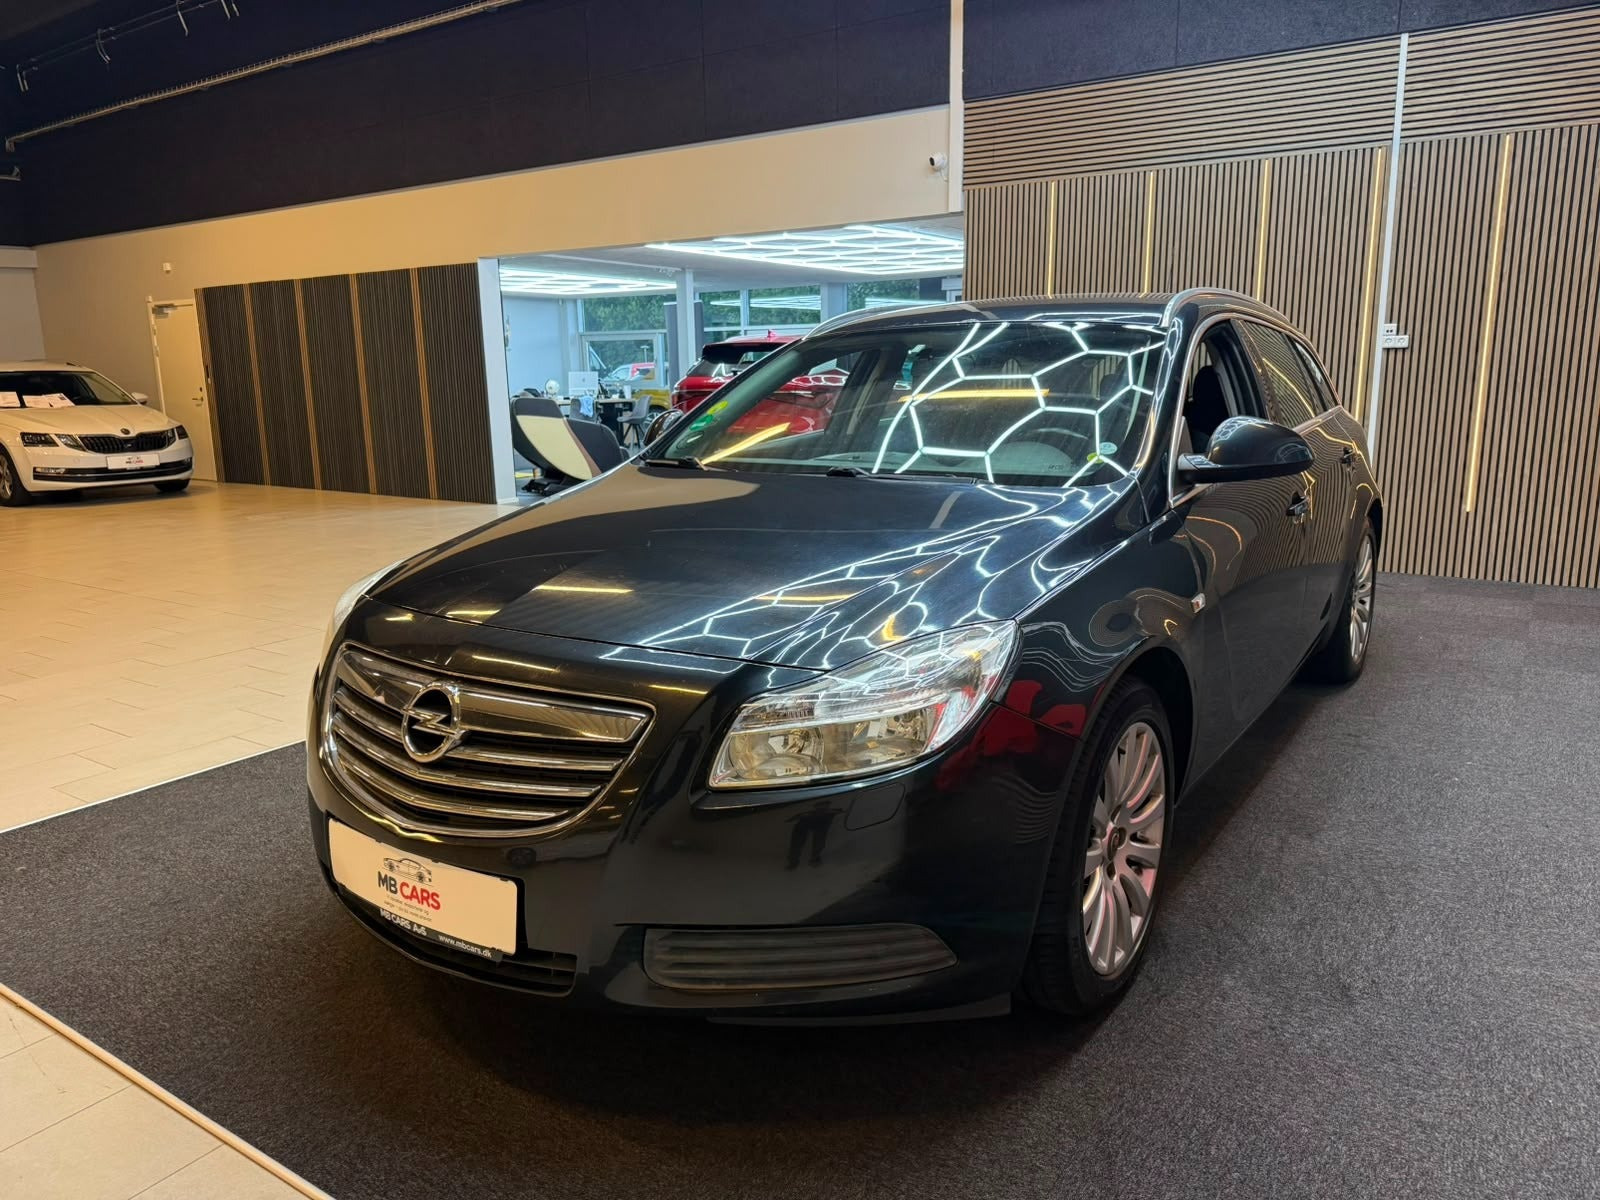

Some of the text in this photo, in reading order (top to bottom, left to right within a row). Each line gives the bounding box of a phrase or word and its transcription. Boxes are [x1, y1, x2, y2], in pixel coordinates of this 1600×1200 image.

[377, 870, 398, 894] MB
[400, 881, 441, 910] CARS
[391, 913, 411, 930] CARS
[438, 934, 492, 958] www.mbcars.dk
